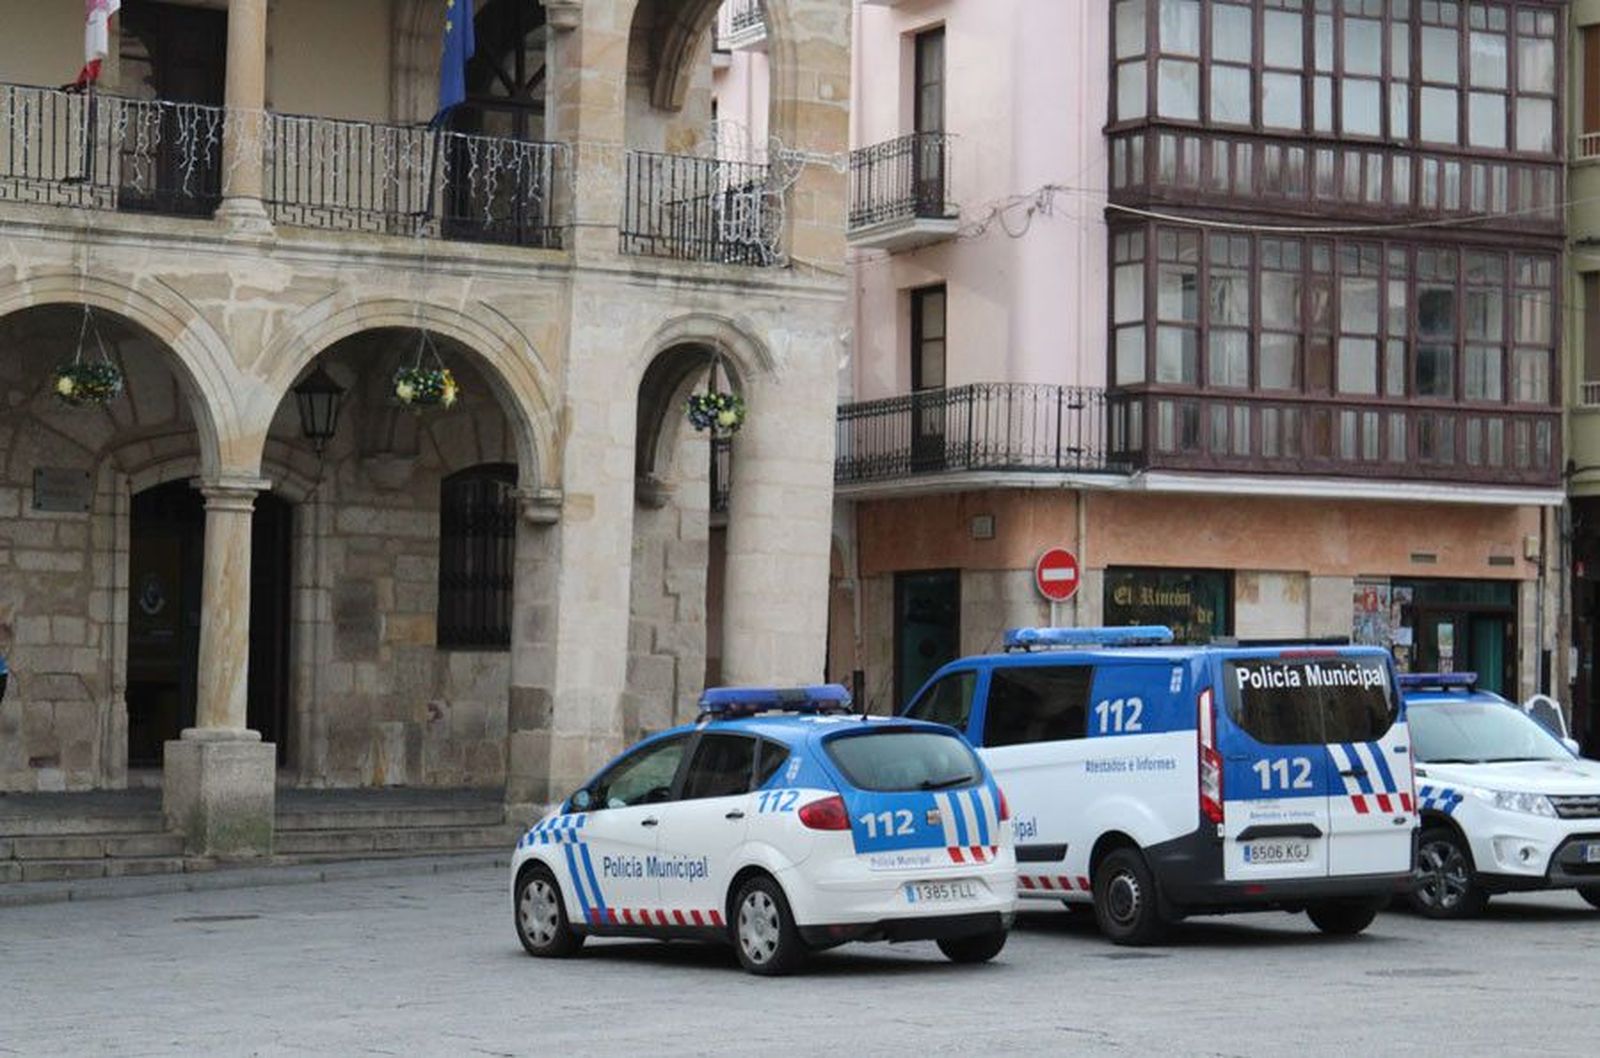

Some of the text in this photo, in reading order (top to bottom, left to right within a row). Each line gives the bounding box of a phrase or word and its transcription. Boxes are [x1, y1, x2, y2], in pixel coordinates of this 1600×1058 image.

[1113, 585, 1132, 606] El
[1235, 664, 1386, 690] Policía Municipal
[1094, 697, 1143, 732] 112
[1085, 759, 1126, 773] Atestados
[1136, 757, 1176, 771] Informes
[1252, 757, 1313, 790] 112
[758, 790, 800, 813] 112
[859, 809, 915, 838] 112
[1251, 843, 1310, 860] 6506 KGJ
[646, 856, 709, 882] Municipal
[916, 884, 976, 900] 1385 FLL
